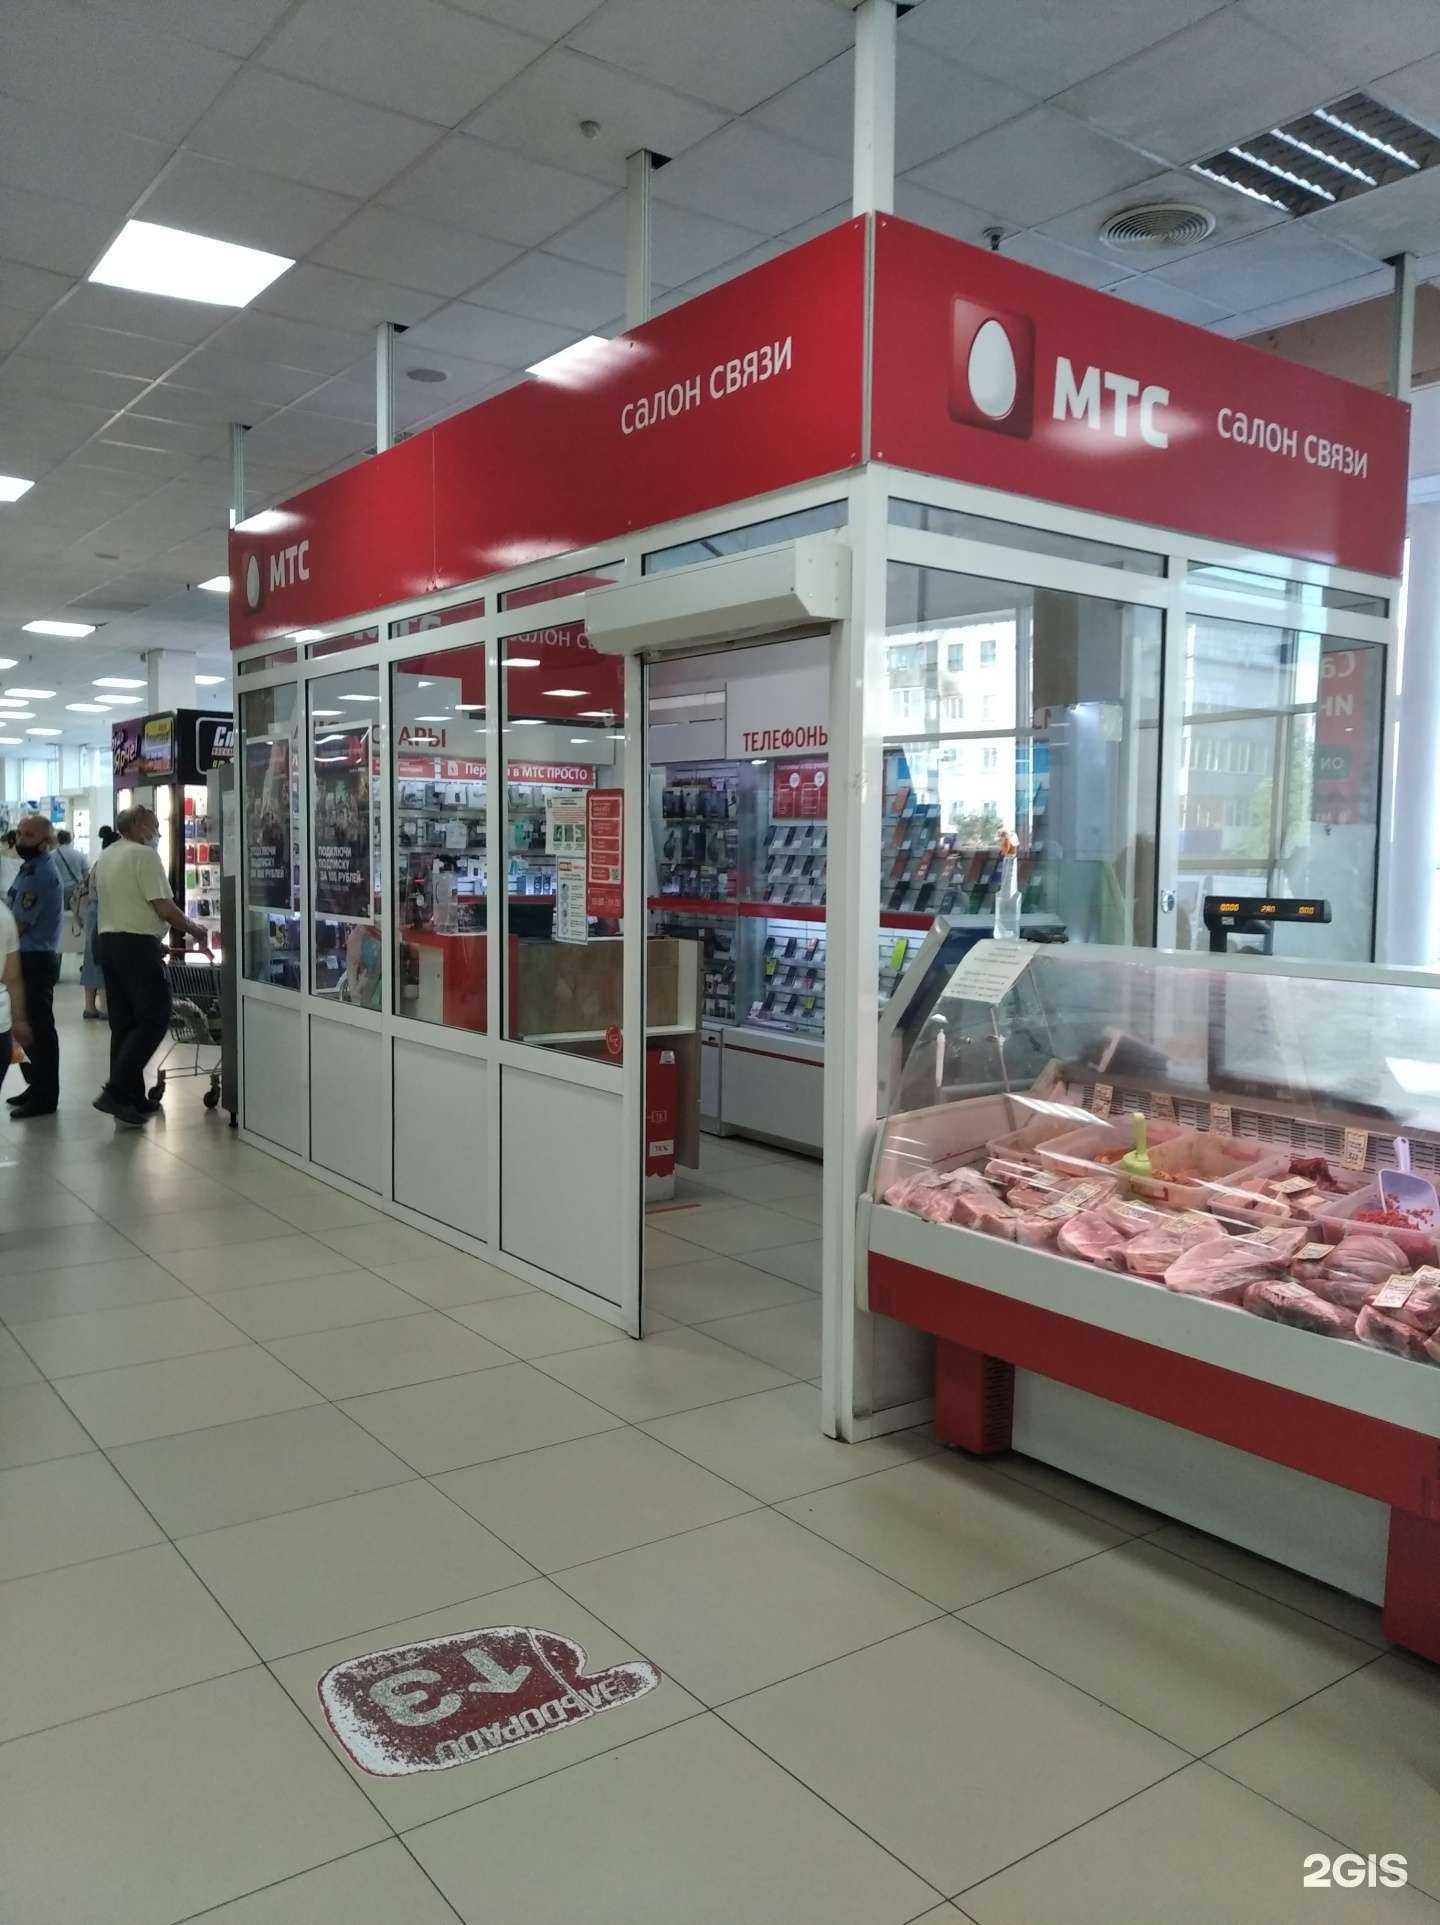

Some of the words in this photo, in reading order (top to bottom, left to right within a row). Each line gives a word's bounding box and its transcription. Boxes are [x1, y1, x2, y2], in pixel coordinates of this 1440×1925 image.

[1052, 356, 1170, 448] МТС
[269, 540, 310, 592] МТС
[522, 766, 545, 779] МТС
[547, 766, 588, 780] ПРОСТО
